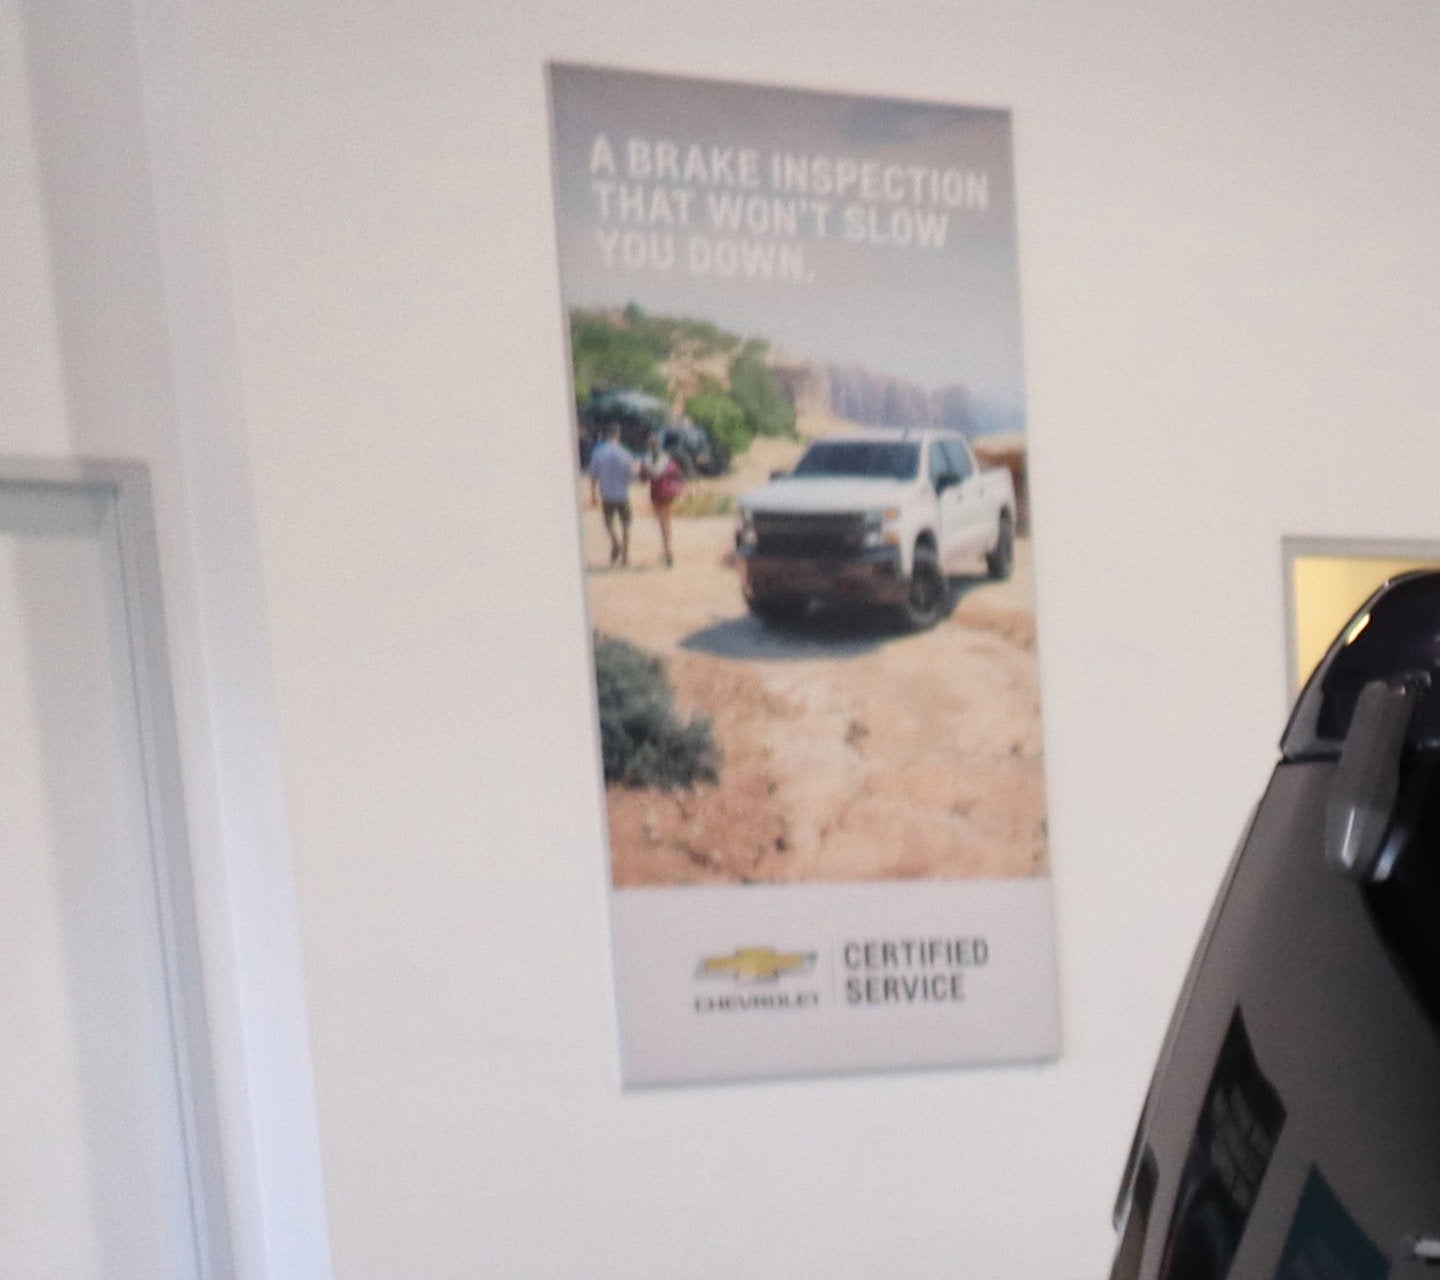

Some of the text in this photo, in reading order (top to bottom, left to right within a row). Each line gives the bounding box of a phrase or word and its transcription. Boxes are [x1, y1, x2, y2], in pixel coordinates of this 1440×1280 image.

[590, 133, 988, 208] A BRAKE INSPECTION
[592, 180, 949, 247] THAT WON'T SLOW
[600, 231, 815, 282] YOU DOWN.
[844, 937, 989, 970] CERTIFIED
[846, 974, 966, 1006] SERVICE
